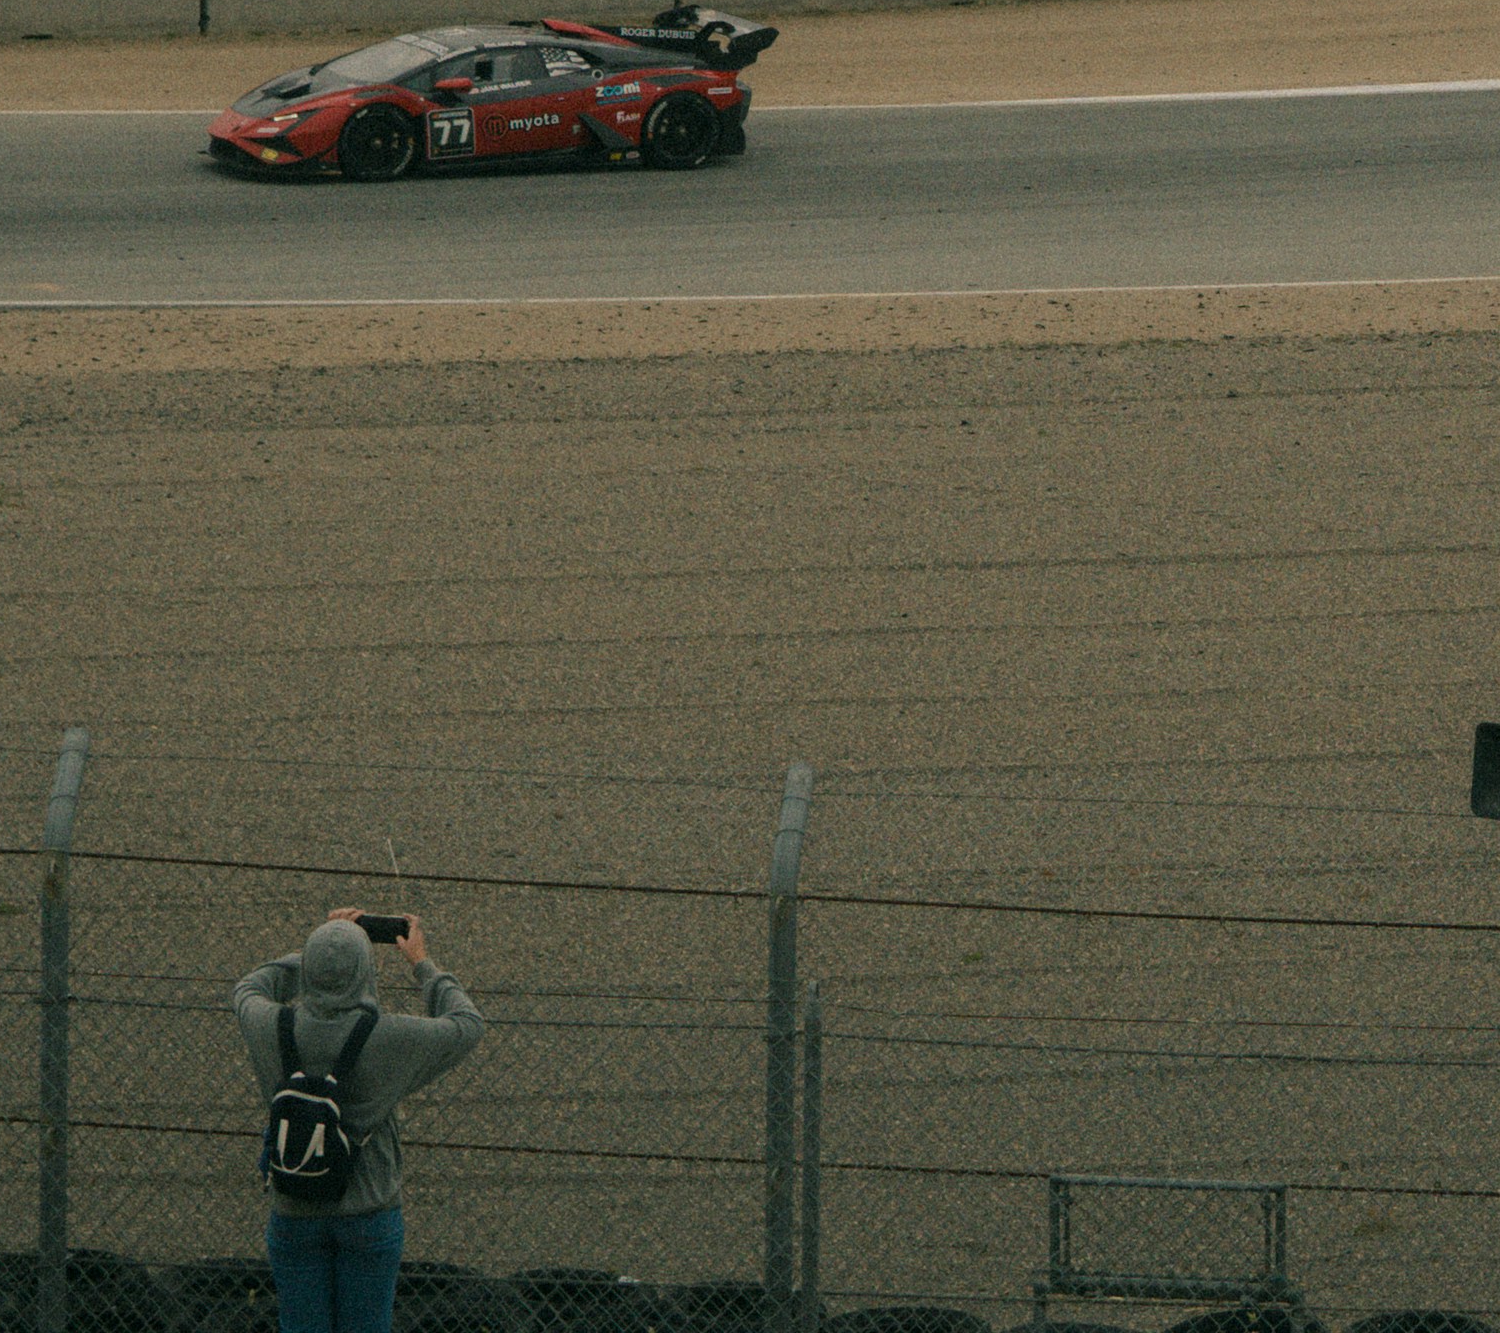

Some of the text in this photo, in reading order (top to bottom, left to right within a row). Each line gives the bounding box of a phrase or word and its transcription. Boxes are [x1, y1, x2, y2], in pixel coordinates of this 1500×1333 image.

[621, 27, 696, 40] ROGER DUBUIS
[510, 113, 560, 131] myota
[433, 118, 472, 147] 77
